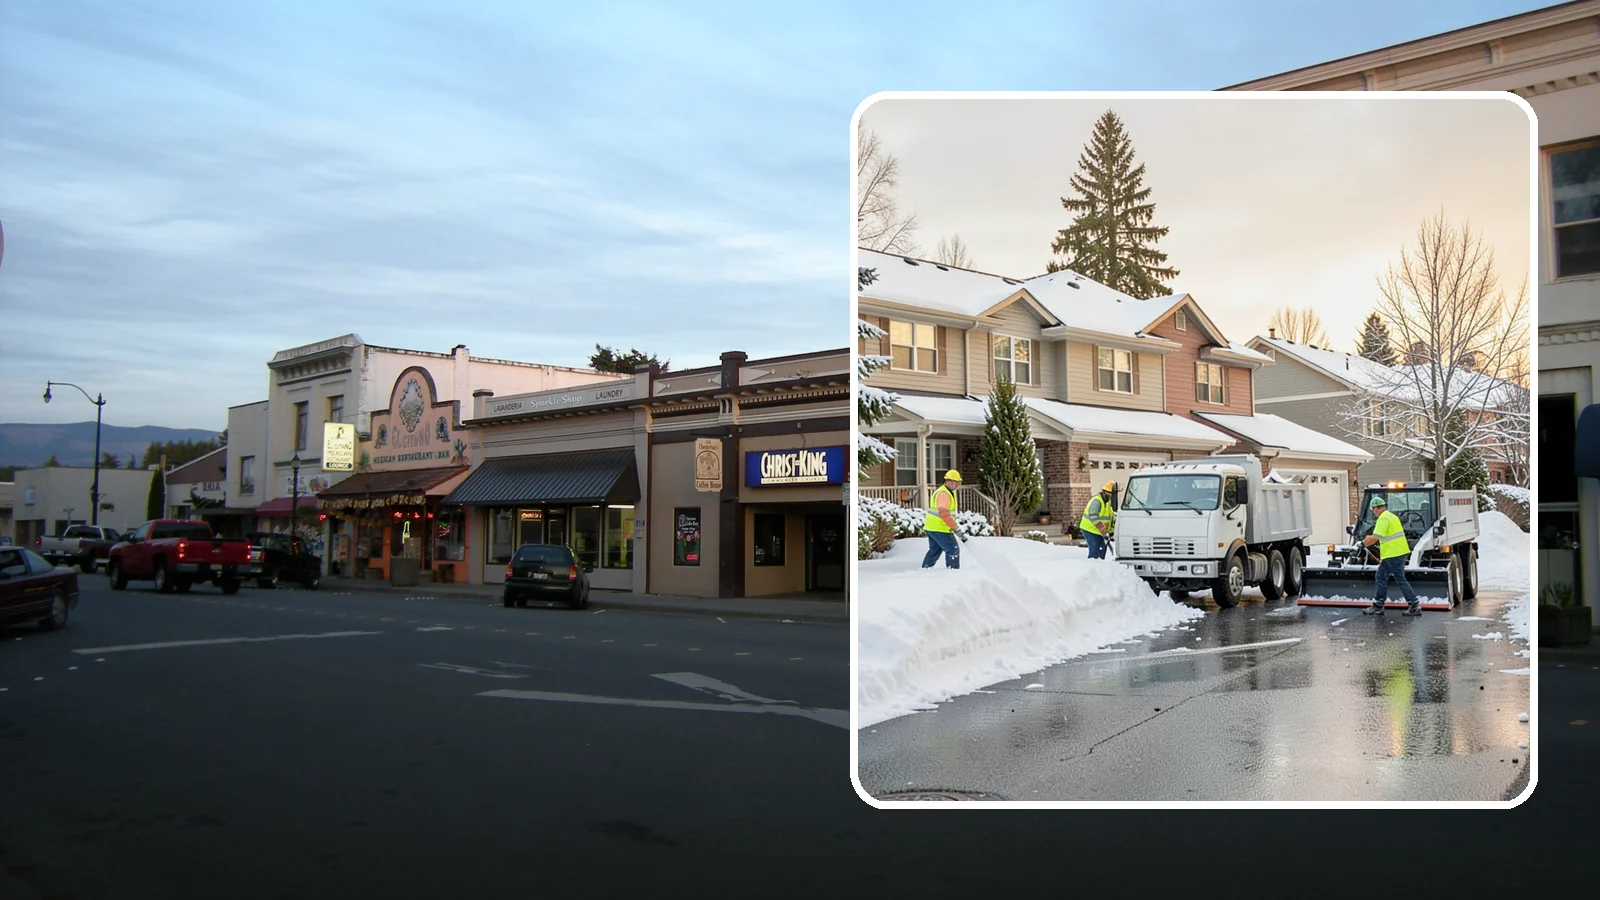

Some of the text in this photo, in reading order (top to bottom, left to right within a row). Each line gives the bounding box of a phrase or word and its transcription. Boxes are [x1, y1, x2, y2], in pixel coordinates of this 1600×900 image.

[493, 389, 624, 413] LAVANDERIA Sparkle Shop LAUNDRY
[373, 455, 396, 465] MEXICAN
[397, 451, 434, 463] RESTAURANT
[437, 450, 450, 459] BAR
[761, 449, 828, 479] CHRIST KING
